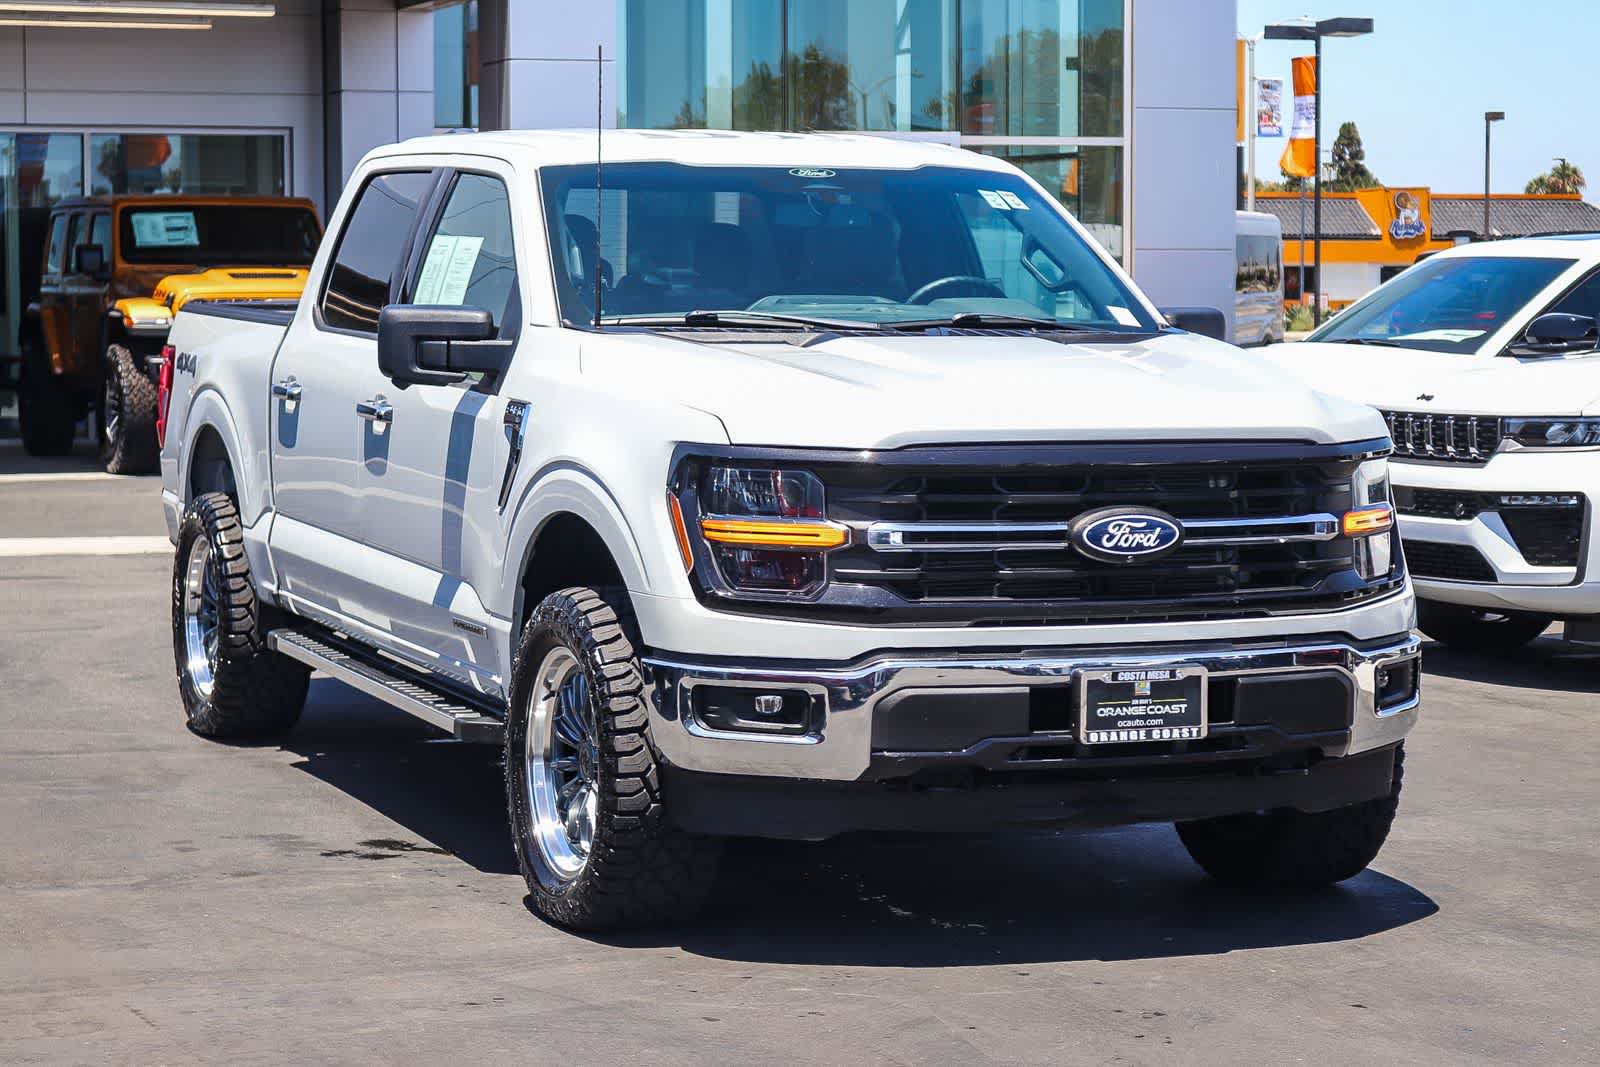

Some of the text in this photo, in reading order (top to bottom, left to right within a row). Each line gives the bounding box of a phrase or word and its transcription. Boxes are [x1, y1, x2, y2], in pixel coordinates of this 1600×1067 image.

[1102, 520, 1161, 548] Ford
[1118, 670, 1170, 681] COSTA MESA
[1117, 718, 1164, 727] ocauto.com
[1089, 727, 1199, 743] ORANGE COAST
